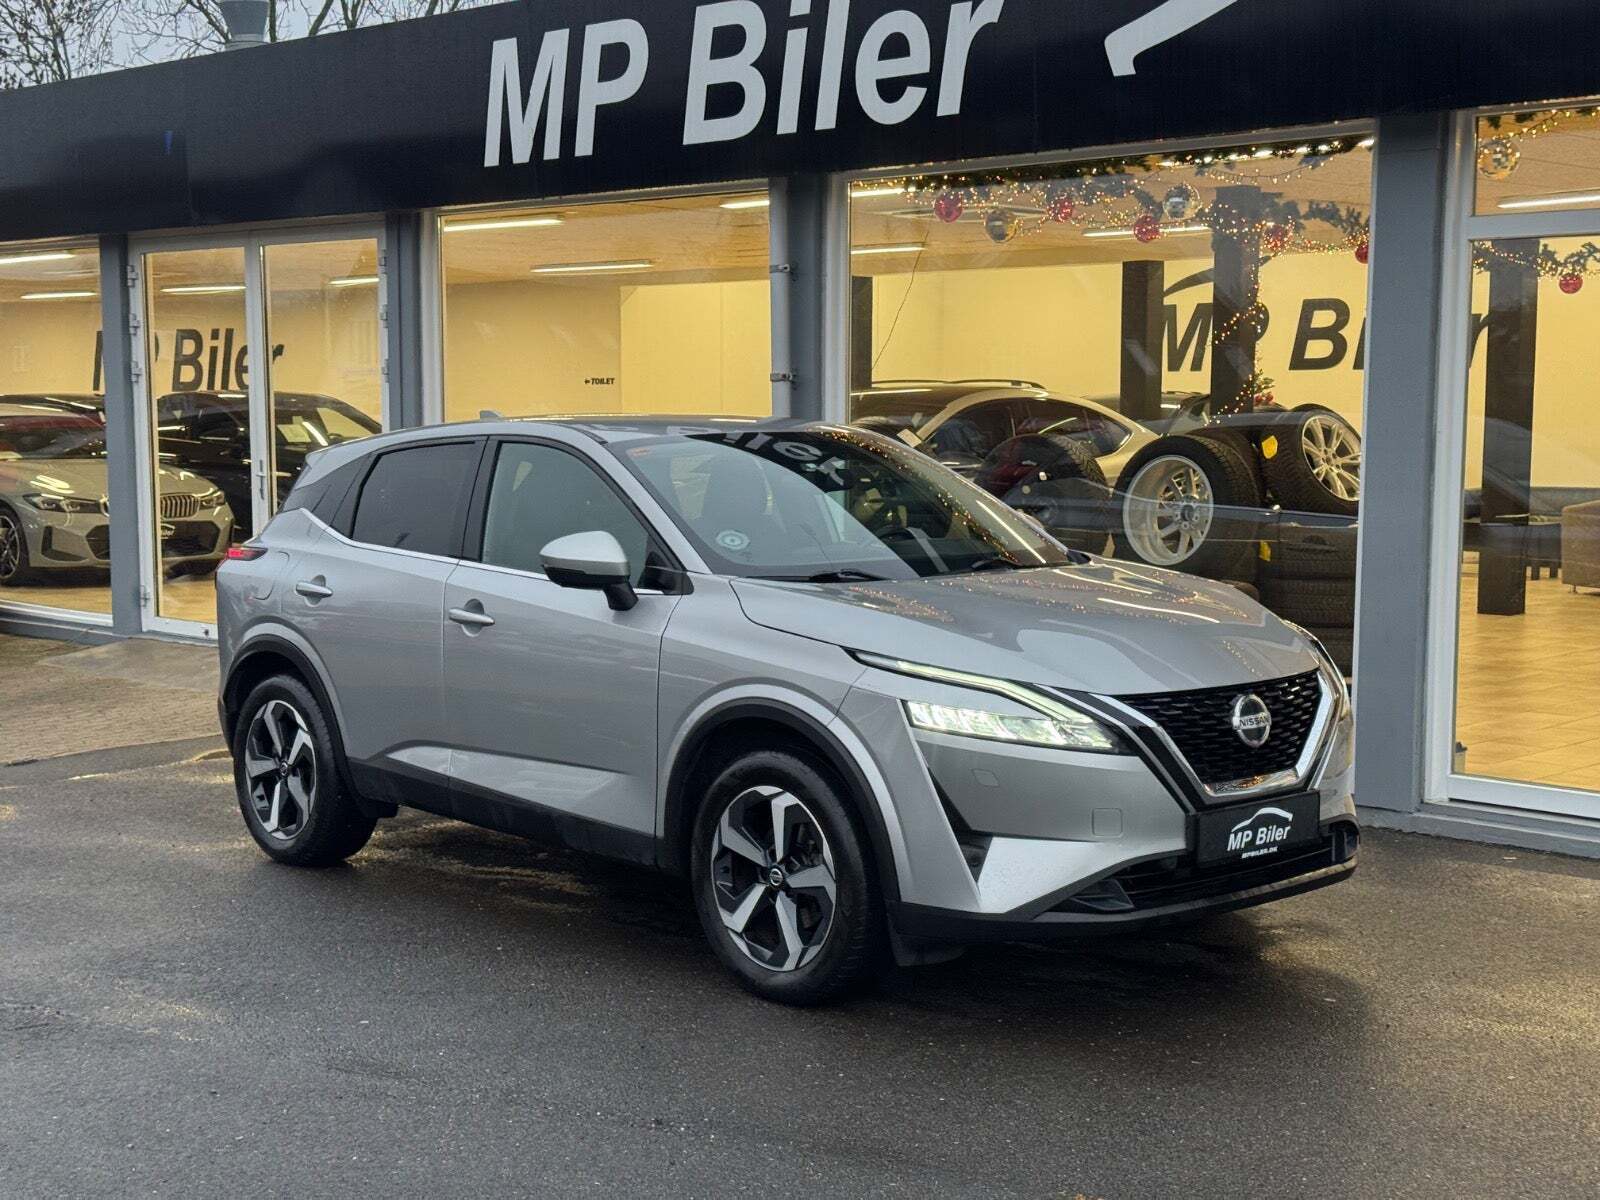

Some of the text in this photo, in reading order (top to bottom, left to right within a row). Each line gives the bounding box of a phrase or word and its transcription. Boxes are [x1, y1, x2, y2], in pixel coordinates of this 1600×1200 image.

[484, 0, 1002, 167] MP Biler
[591, 377, 615, 385] TOILET
[1239, 714, 1268, 726] NISSAN
[1227, 825, 1291, 851] MP Biler
